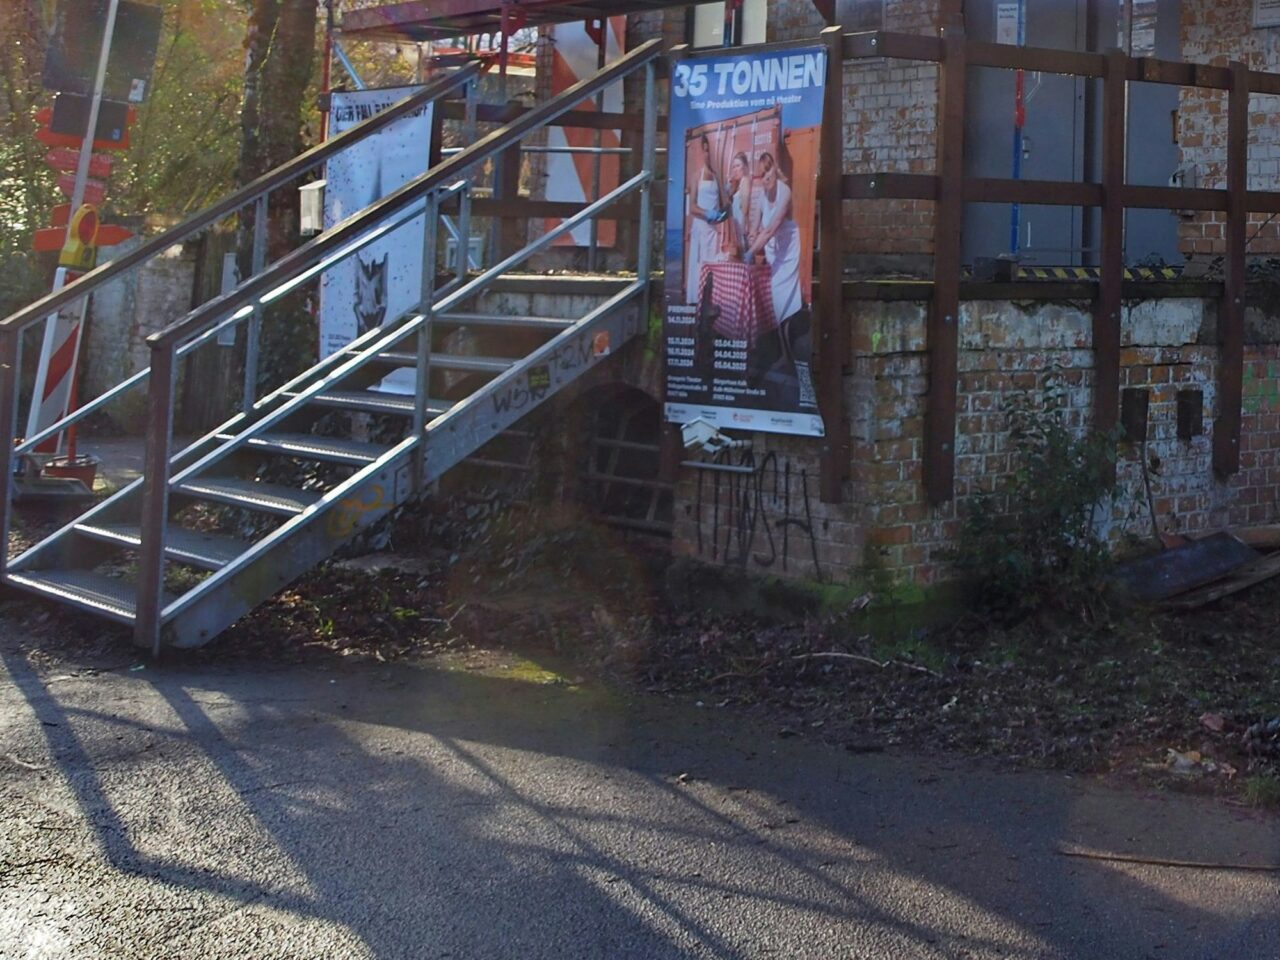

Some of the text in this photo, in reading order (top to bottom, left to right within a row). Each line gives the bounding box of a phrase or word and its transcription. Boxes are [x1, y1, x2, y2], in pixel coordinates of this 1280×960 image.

[673, 52, 824, 97] 35 TONNEN
[707, 99, 749, 109] Produktion
